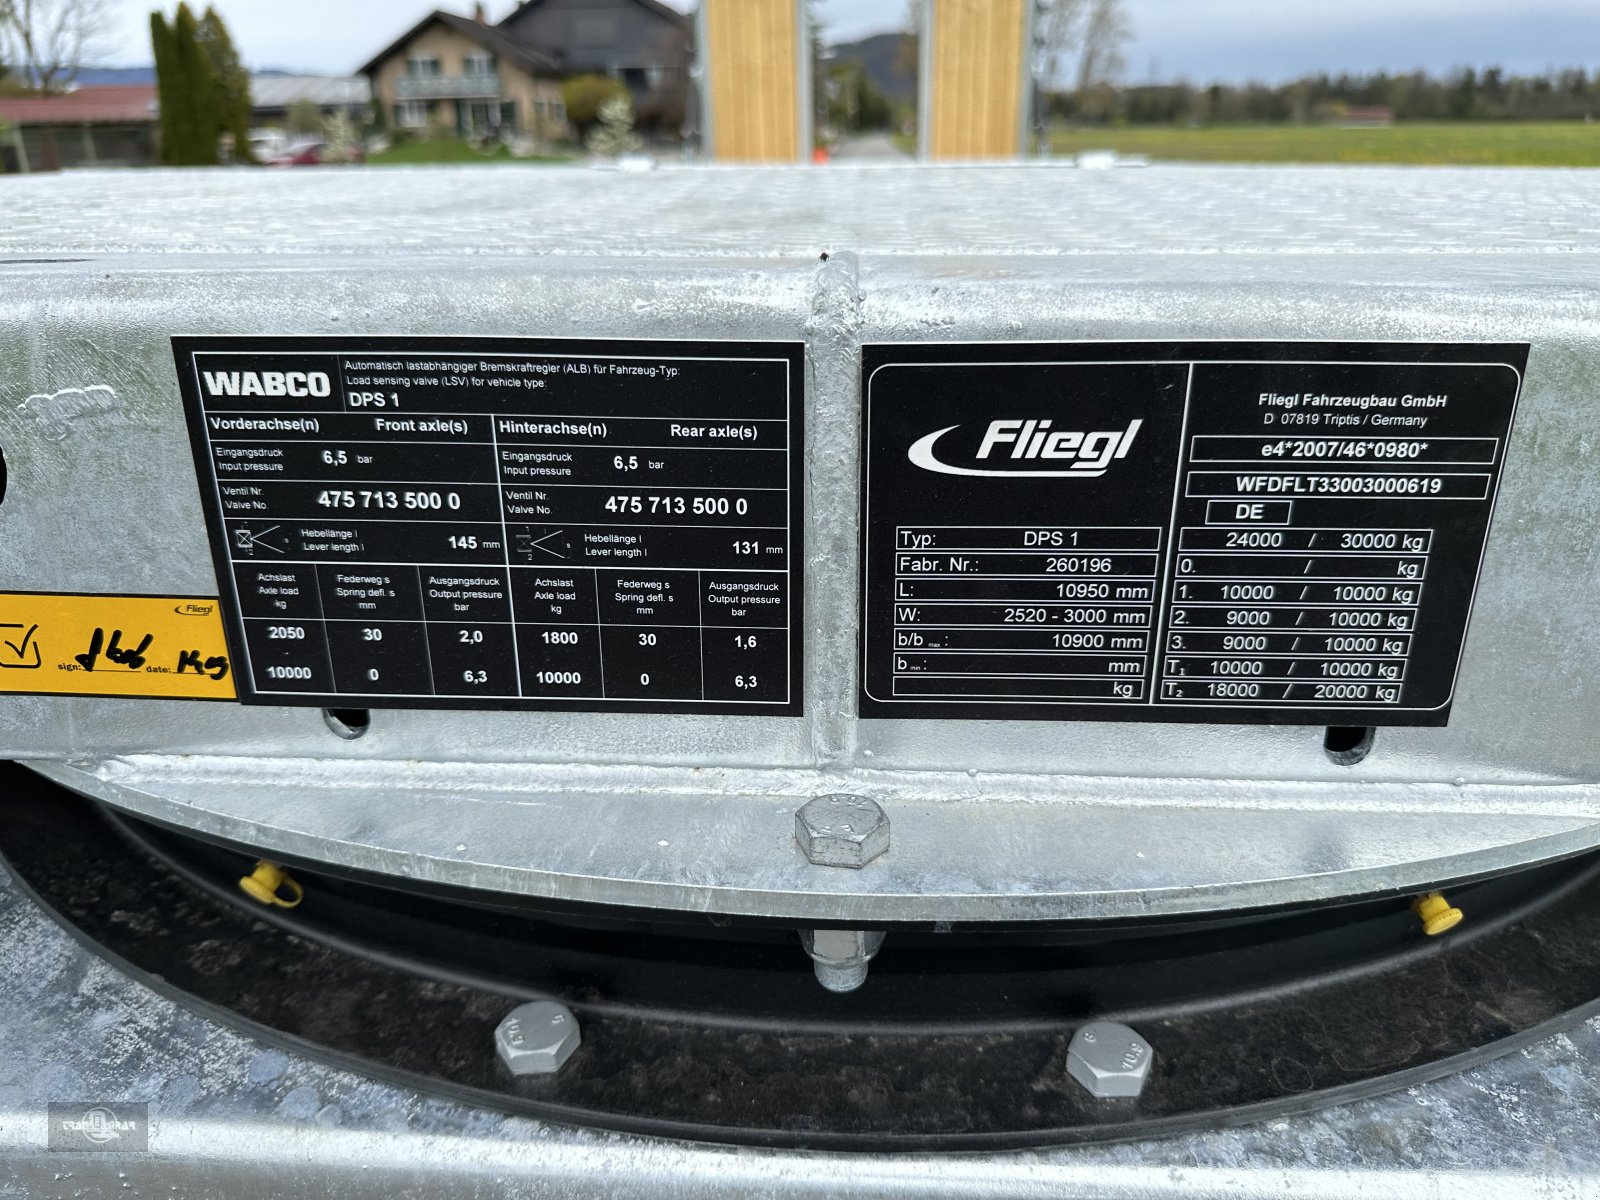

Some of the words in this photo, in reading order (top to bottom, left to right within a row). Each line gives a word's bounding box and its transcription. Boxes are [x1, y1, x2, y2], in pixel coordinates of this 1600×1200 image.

[345, 361, 404, 370] Automatisch
[406, 361, 478, 373] lastabhängiger
[480, 361, 560, 375] Bremskraftregler
[563, 363, 591, 374] (ALB)
[593, 364, 607, 374] für
[609, 364, 680, 377] Fahrzeug-Typ:
[203, 371, 331, 397] WABCO
[347, 376, 371, 385] Load
[373, 377, 410, 388] sensing
[412, 377, 439, 386] valve
[441, 376, 469, 387] (LSV)
[471, 376, 485, 386] for
[487, 378, 521, 387] vehicle
[349, 392, 386, 407] DPS
[391, 393, 399, 407] 1
[1258, 393, 1299, 409] Fliegl
[1302, 393, 1397, 409] Fahrzeugbau
[1401, 394, 1447, 407] GmbH
[210, 417, 319, 433] Vorderachse(n)
[375, 418, 416, 431] Front
[419, 419, 468, 435] axle(s)
[1264, 413, 1274, 424] D
[1281, 413, 1320, 425] 07819
[1323, 413, 1360, 427] Triptis
[1371, 414, 1428, 429] Germany
[499, 420, 607, 438] Hinterachse(n)
[671, 424, 705, 437] Rear
[709, 425, 757, 440] axle(s)
[976, 419, 1143, 469] Fliegl
[216, 447, 284, 459] Eingangsdruck
[323, 450, 347, 466] 6,5
[357, 455, 373, 464] bar
[502, 451, 573, 463] Eingangsdruck
[219, 462, 242, 472] Input
[243, 463, 283, 472] pressure
[614, 455, 638, 472] 6,5
[648, 460, 664, 469] bar
[504, 466, 528, 476] Input
[530, 468, 571, 476] pressure
[222, 487, 249, 495] Ventil
[1236, 476, 1442, 493] WFDFLT33003000619
[318, 490, 355, 508] 475
[360, 491, 398, 508] 713
[404, 492, 442, 509] 500
[448, 492, 460, 510] 0
[505, 491, 533, 500] Ventil
[225, 501, 251, 509] Valve
[507, 505, 534, 514] Valve
[605, 496, 642, 513] 475
[648, 497, 685, 514] 713
[693, 497, 729, 515] 500
[736, 498, 747, 515] 0
[1235, 504, 1264, 519] DE
[301, 529, 353, 540] Hebellänge
[584, 534, 637, 545] Hebellänge
[899, 531, 937, 550] Typ:
[1024, 531, 1063, 546] DPS
[1070, 531, 1078, 546] 1
[303, 542, 329, 551] Lever
[331, 543, 359, 553] length
[448, 536, 477, 549] 145
[733, 541, 758, 554] 131
[1225, 532, 1282, 547] 24000
[1340, 533, 1396, 548] 30000
[1401, 534, 1424, 552] kg
[585, 547, 612, 556] Lever
[614, 548, 642, 558] length
[900, 557, 942, 571] Fabr.
[950, 557, 979, 571] Nr.:
[1046, 557, 1112, 572] 260196
[1181, 558, 1196, 573] 0.
[1396, 561, 1420, 579] kg
[258, 573, 296, 582] Achslast
[337, 574, 382, 586] Federweg
[429, 576, 500, 587] Ausgangsdruck
[534, 578, 574, 587] Achslast
[259, 586, 278, 595] Axle
[280, 587, 299, 595] load
[617, 579, 662, 591] Federweg
[709, 581, 779, 592] Ausgangsdruck
[900, 582, 913, 596] L:
[1057, 583, 1109, 598] 10950
[1116, 587, 1148, 598] mm
[336, 587, 366, 598] Spring
[429, 589, 461, 599] Output
[462, 591, 503, 600] pressure
[534, 591, 554, 600] Axle
[556, 592, 576, 600] load
[615, 592, 644, 603] Spring
[1179, 585, 1192, 599] 1.
[1221, 585, 1274, 600] 10000
[1334, 586, 1386, 601] 10000
[1391, 587, 1414, 605] kg
[274, 600, 287, 610] kg
[708, 594, 739, 605] Output
[741, 597, 780, 605] pressure
[186, 604, 214, 614] Fliegl
[454, 603, 470, 611] bar
[550, 605, 562, 615] kg
[731, 608, 747, 616] bar
[898, 608, 920, 621] W:
[1004, 608, 1046, 622] 2520
[1064, 609, 1107, 623] 3000
[1113, 613, 1145, 623] mm
[1174, 610, 1189, 624] 2.
[1226, 611, 1270, 625] 9000
[1329, 612, 1382, 626] 10000
[1386, 612, 1409, 630] kg
[268, 626, 305, 639] 2050
[363, 628, 382, 641] 30
[459, 630, 483, 644] 2,0
[542, 631, 578, 644] 1800
[898, 632, 923, 646] b/b
[639, 633, 656, 646] 30
[735, 635, 757, 650] 1,6
[1053, 634, 1104, 648] 10900
[1111, 638, 1143, 648] mm
[1171, 635, 1186, 649] 3.
[1223, 636, 1267, 650] 9000
[1325, 637, 1377, 652] 10000
[1381, 638, 1404, 656] kg
[57, 663, 82, 672] sign:
[145, 665, 172, 674] date:
[267, 666, 312, 679] 10000
[1108, 662, 1140, 673] mm
[1210, 661, 1263, 675] 10000
[1321, 662, 1372, 676] 10000
[1376, 663, 1400, 680] kg
[369, 668, 379, 681] 0
[464, 670, 487, 684] 6,3
[536, 671, 581, 684] 10000
[640, 673, 649, 685] 0
[735, 675, 757, 689] 6,3
[1112, 681, 1133, 697] kg
[1208, 683, 1259, 697] 18000
[1314, 685, 1368, 699] 20000
[1374, 685, 1397, 702] kg
